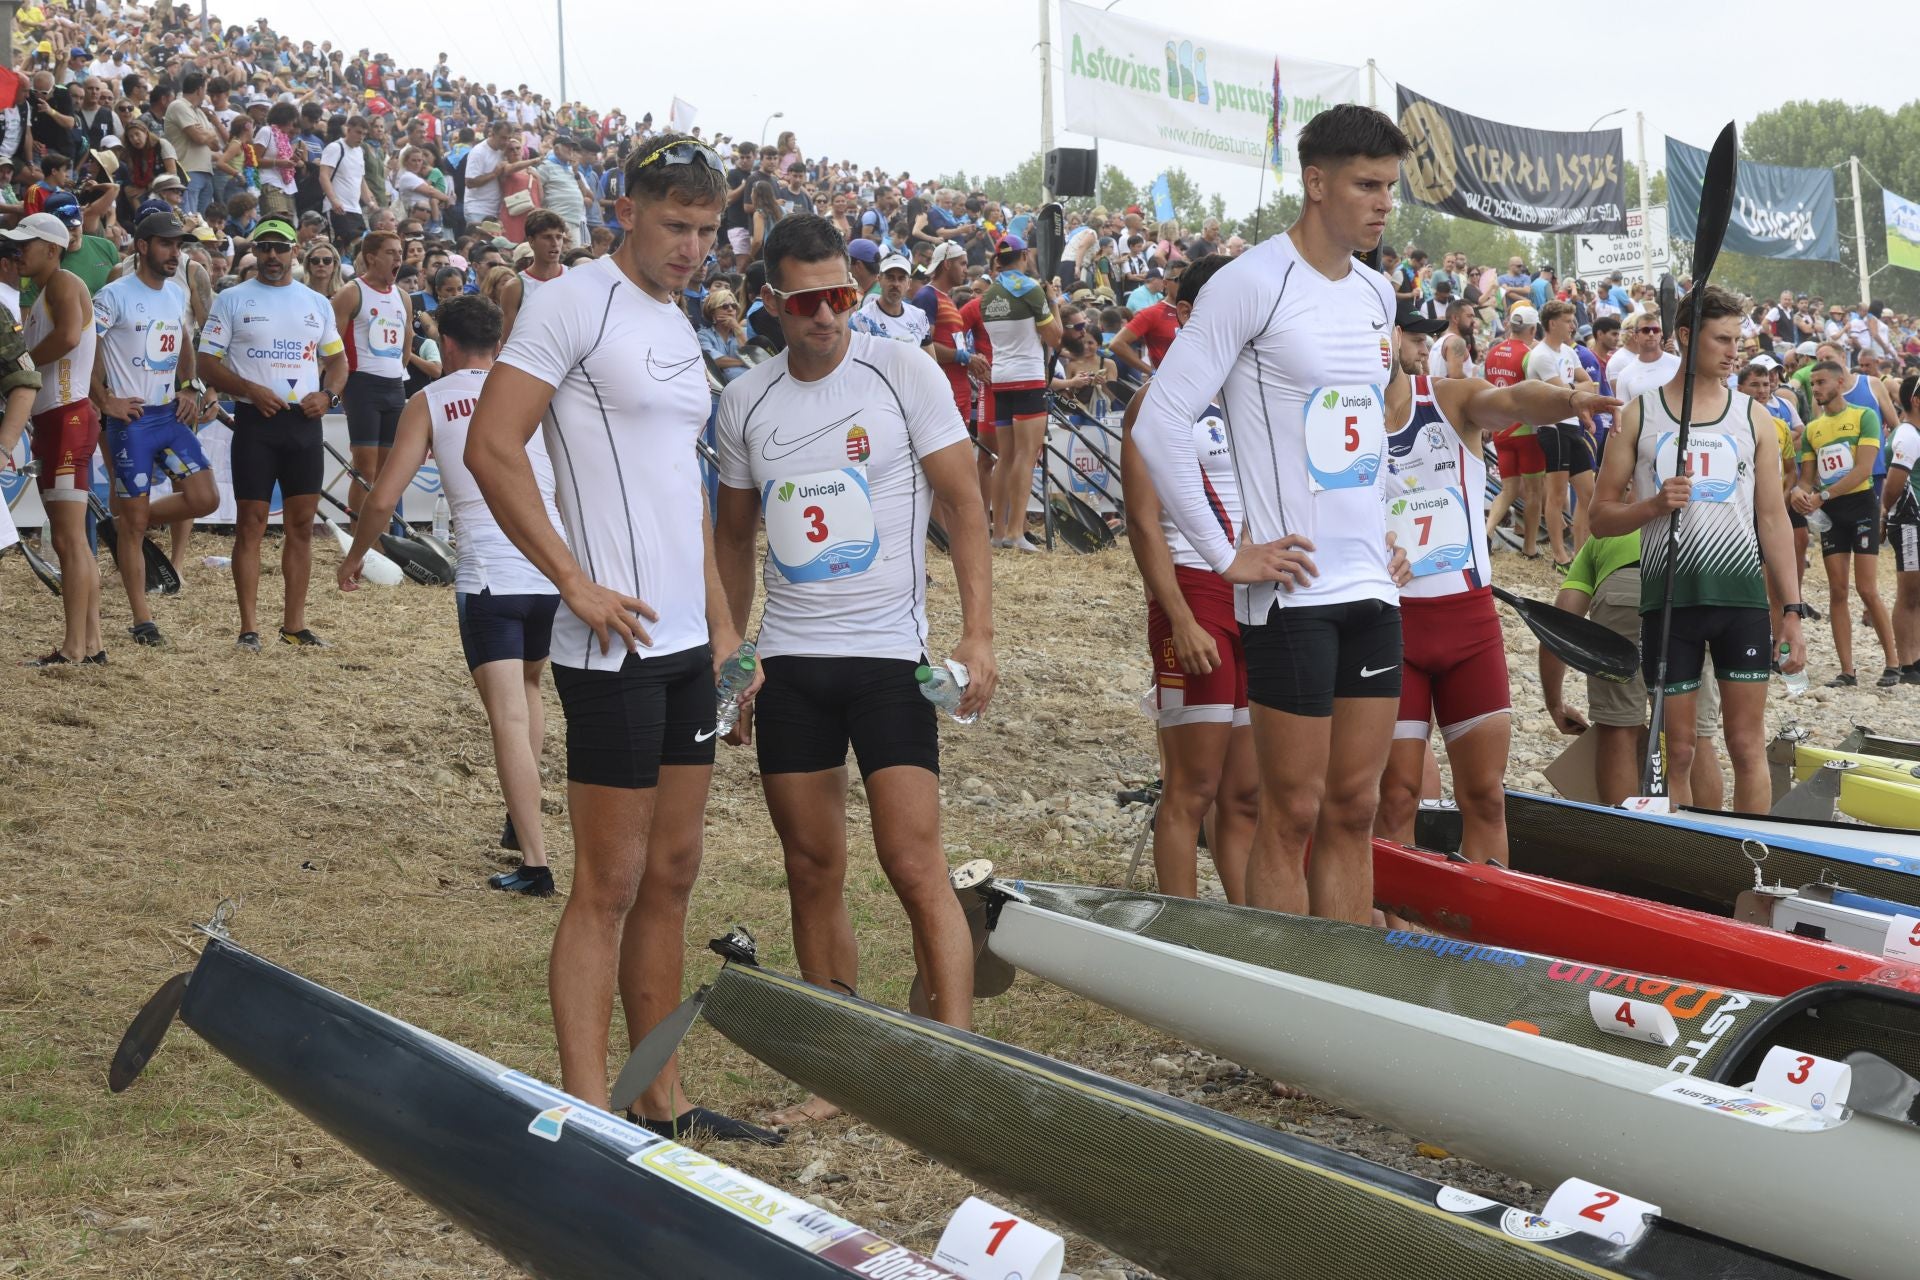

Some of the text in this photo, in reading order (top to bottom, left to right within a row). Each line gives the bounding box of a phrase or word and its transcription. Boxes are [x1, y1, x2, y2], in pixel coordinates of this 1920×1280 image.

[1071, 32, 1161, 93] Asturias
[1464, 144, 1551, 193] TIERRA
[1739, 196, 1816, 250] Unicaja
[1598, 247, 1664, 264] COVADOGA
[160, 334, 175, 352] 28
[273, 338, 301, 350] Islas
[383, 329, 397, 345] 13
[246, 348, 301, 361] Canarias
[1341, 394, 1372, 411] Unicaja
[1344, 416, 1360, 452] 5
[1690, 438, 1722, 450] Unicaja
[1075, 457, 1104, 472] SELLA
[1822, 455, 1844, 472] 131
[798, 481, 846, 499] Unicaja
[1410, 496, 1449, 512] Unicaja
[803, 506, 829, 543] 3
[1414, 515, 1433, 547] 7
[1615, 1002, 1636, 1028] 4
[1787, 1055, 1815, 1084] 3
[1673, 1087, 1768, 1117] AUSTROTHERM
[1579, 1191, 1621, 1223] 2
[985, 1219, 1019, 1256] 1
